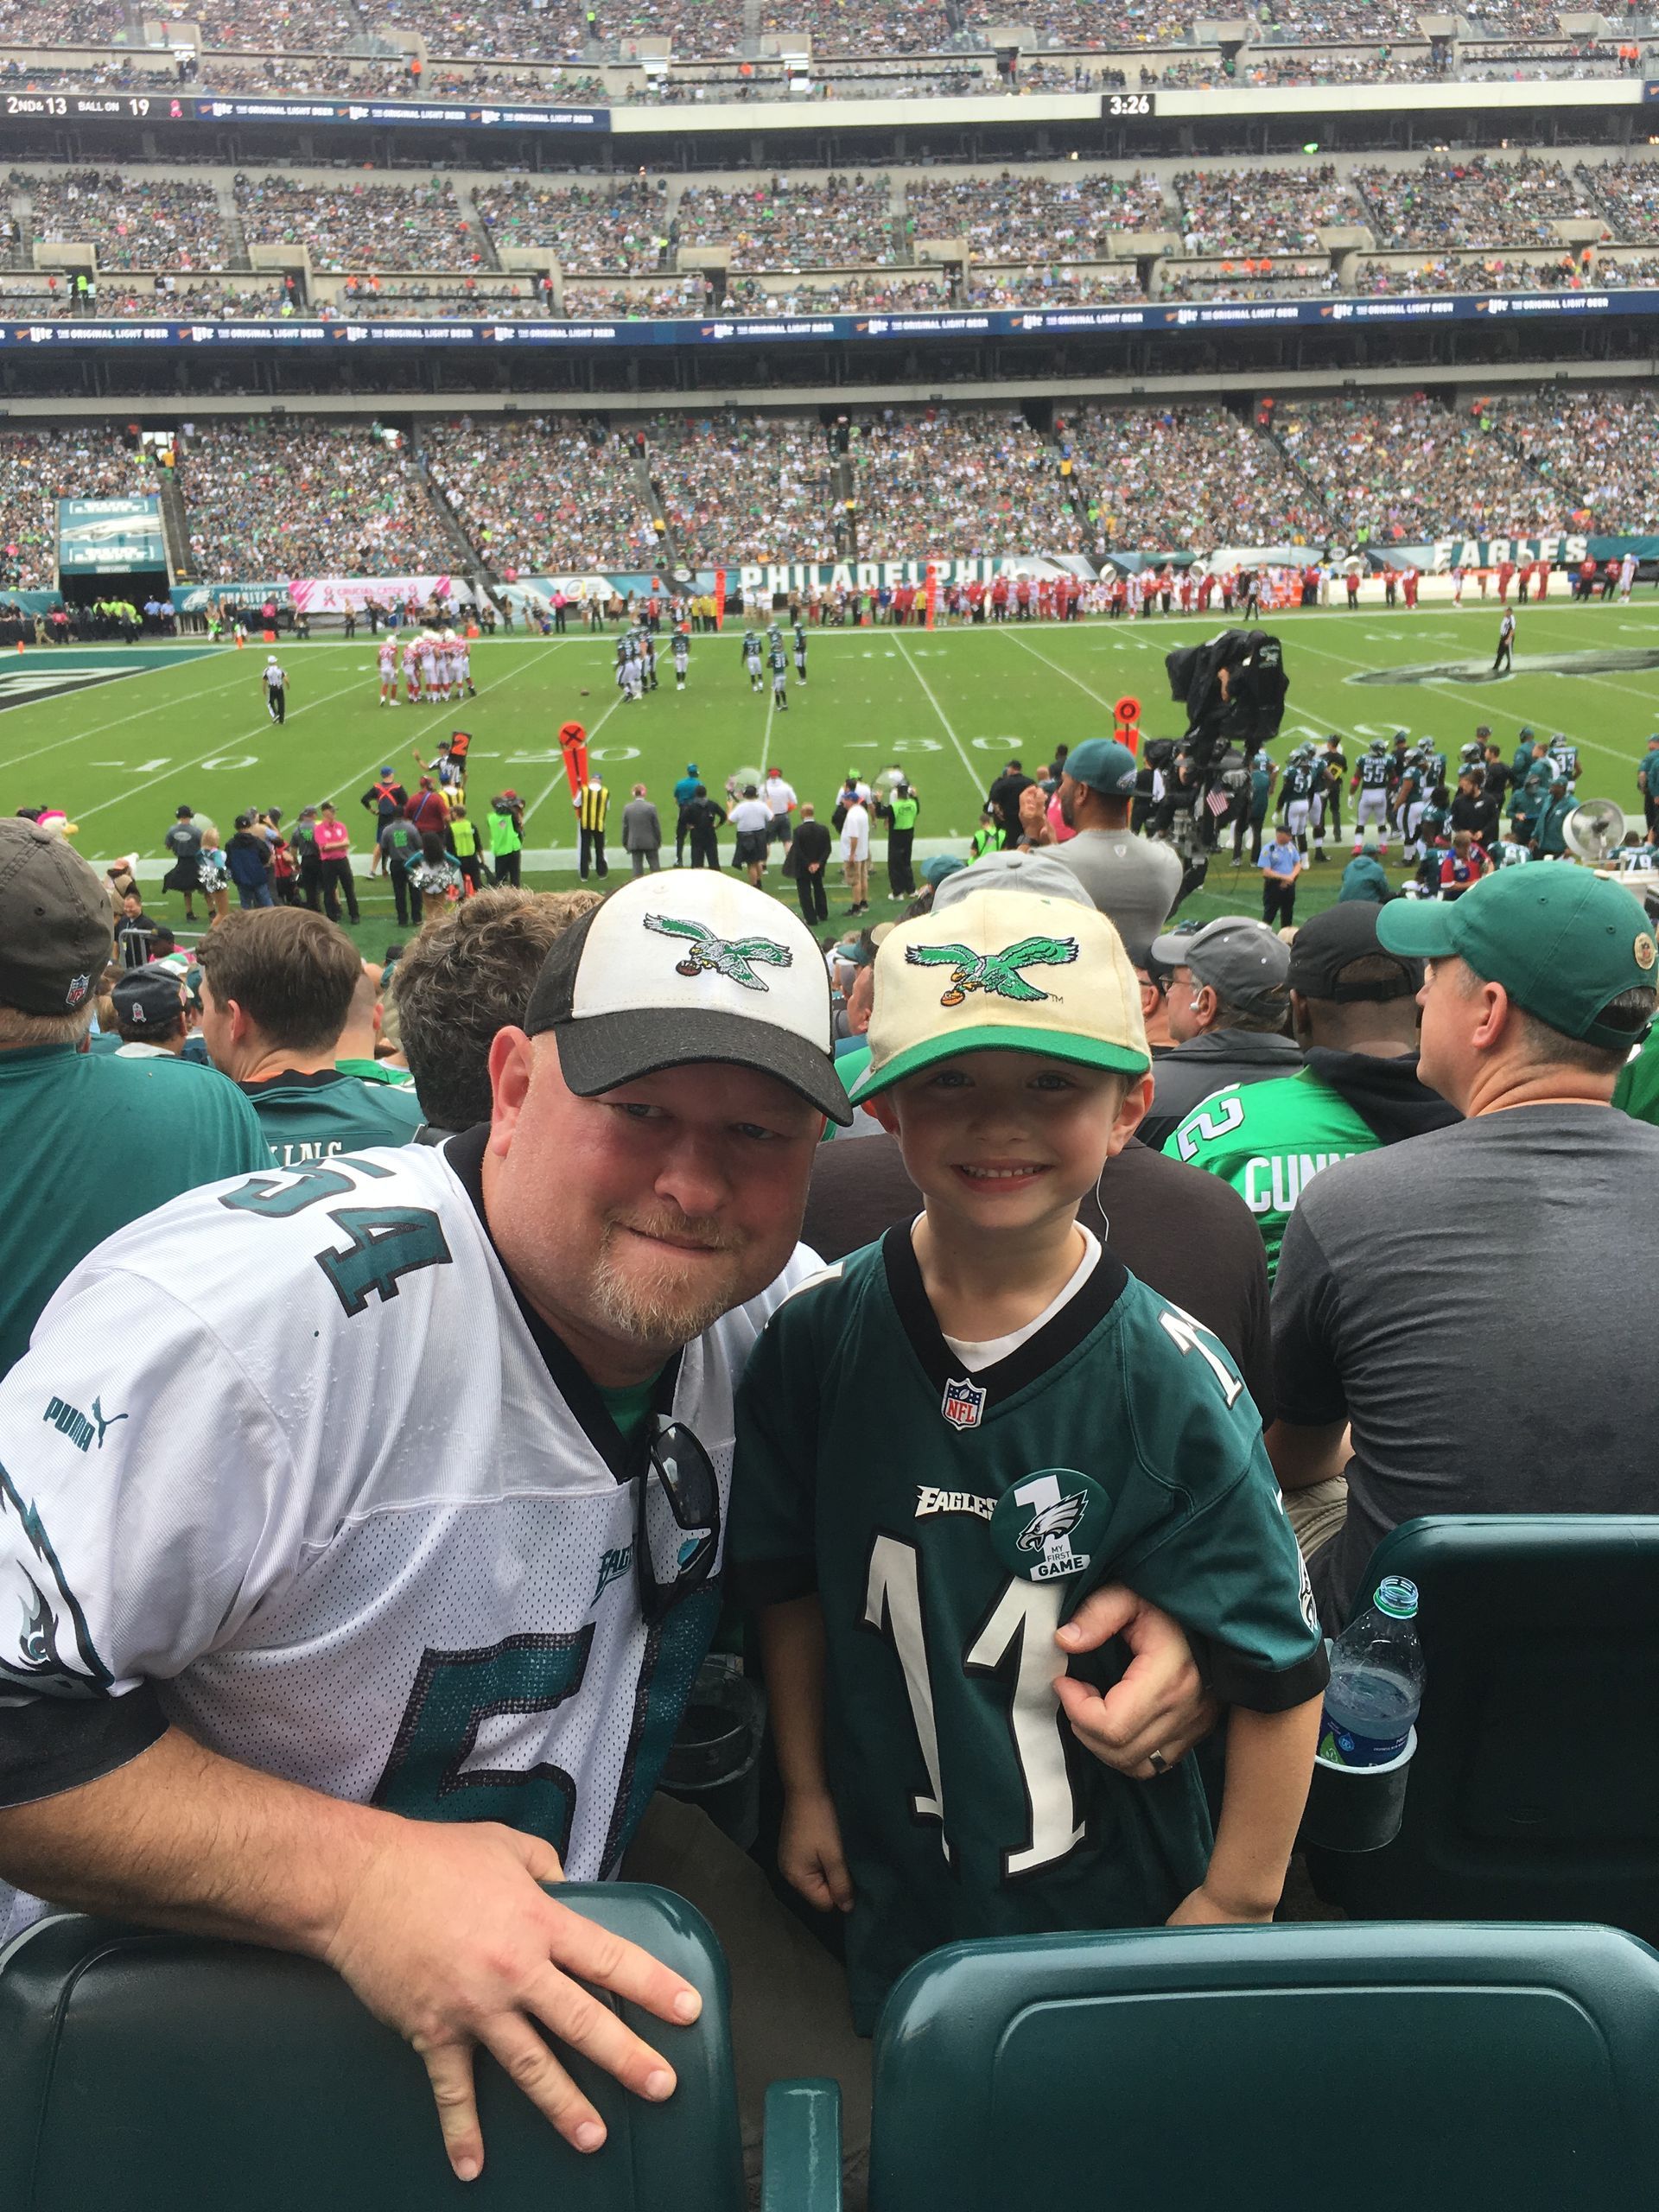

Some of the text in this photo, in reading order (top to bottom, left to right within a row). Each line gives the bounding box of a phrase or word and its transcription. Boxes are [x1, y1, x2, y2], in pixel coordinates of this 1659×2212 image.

[46, 98, 67, 115] 13
[78, 99, 149, 116] BALL ON 19
[1109, 95, 1150, 115] 3:26
[1433, 534, 1588, 569] EAGLES
[450, 734, 470, 756] 2
[1555, 753, 1576, 772] 33
[1363, 764, 1385, 784] 55
[1626, 855, 1652, 870] 79
[946, 1400, 976, 1423] NFL
[42, 1395, 96, 1452] PUMA
[914, 1484, 999, 1521] EAGLES
[1046, 1550, 1071, 1562] FIRST
[1052, 1544, 1065, 1554] MY
[1038, 1556, 1084, 1577] GAME
[861, 1528, 1090, 1885] 11
